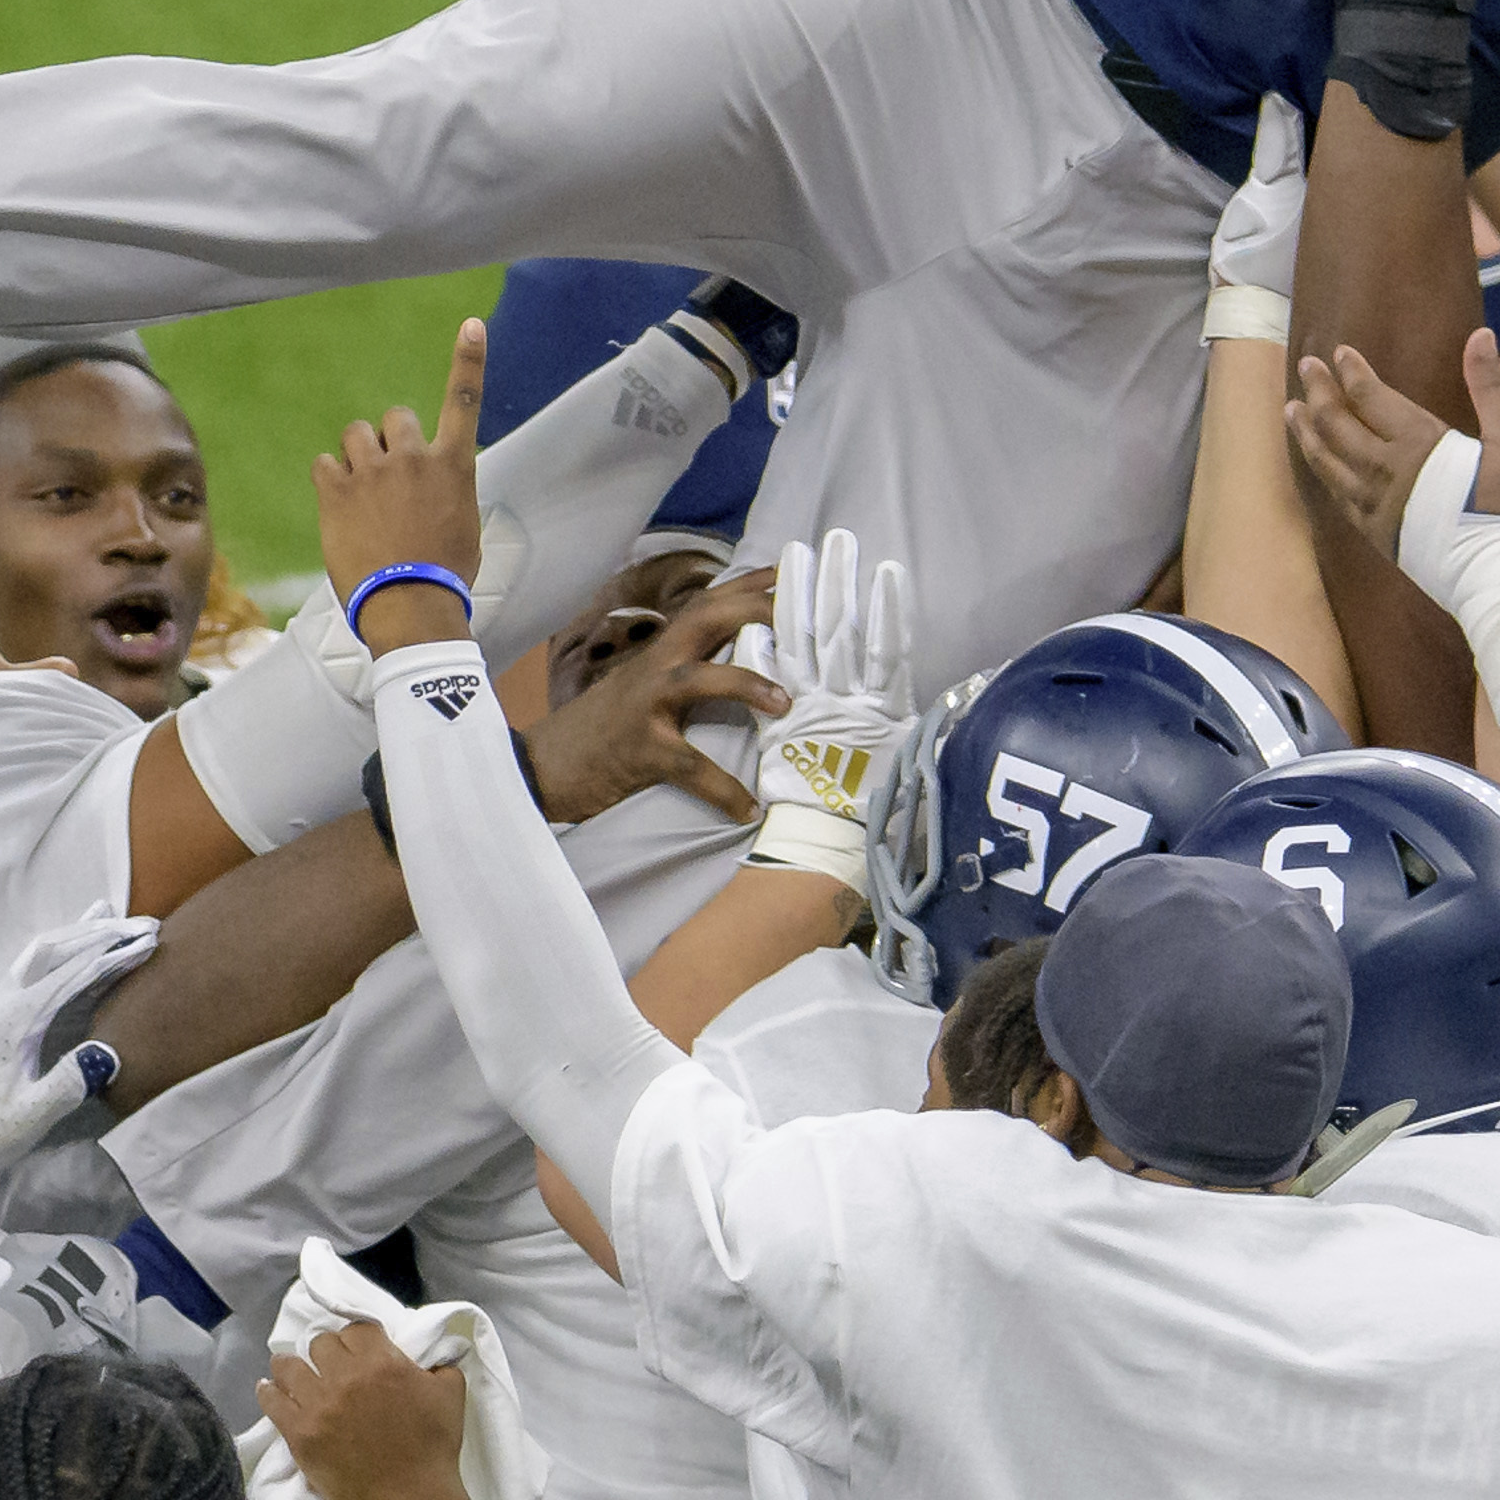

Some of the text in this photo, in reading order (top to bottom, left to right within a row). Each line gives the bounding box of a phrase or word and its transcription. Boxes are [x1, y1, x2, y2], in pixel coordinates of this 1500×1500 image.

[410, 673, 481, 699] adidas
[782, 742, 858, 819] adidas
[979, 751, 1153, 915] 57
